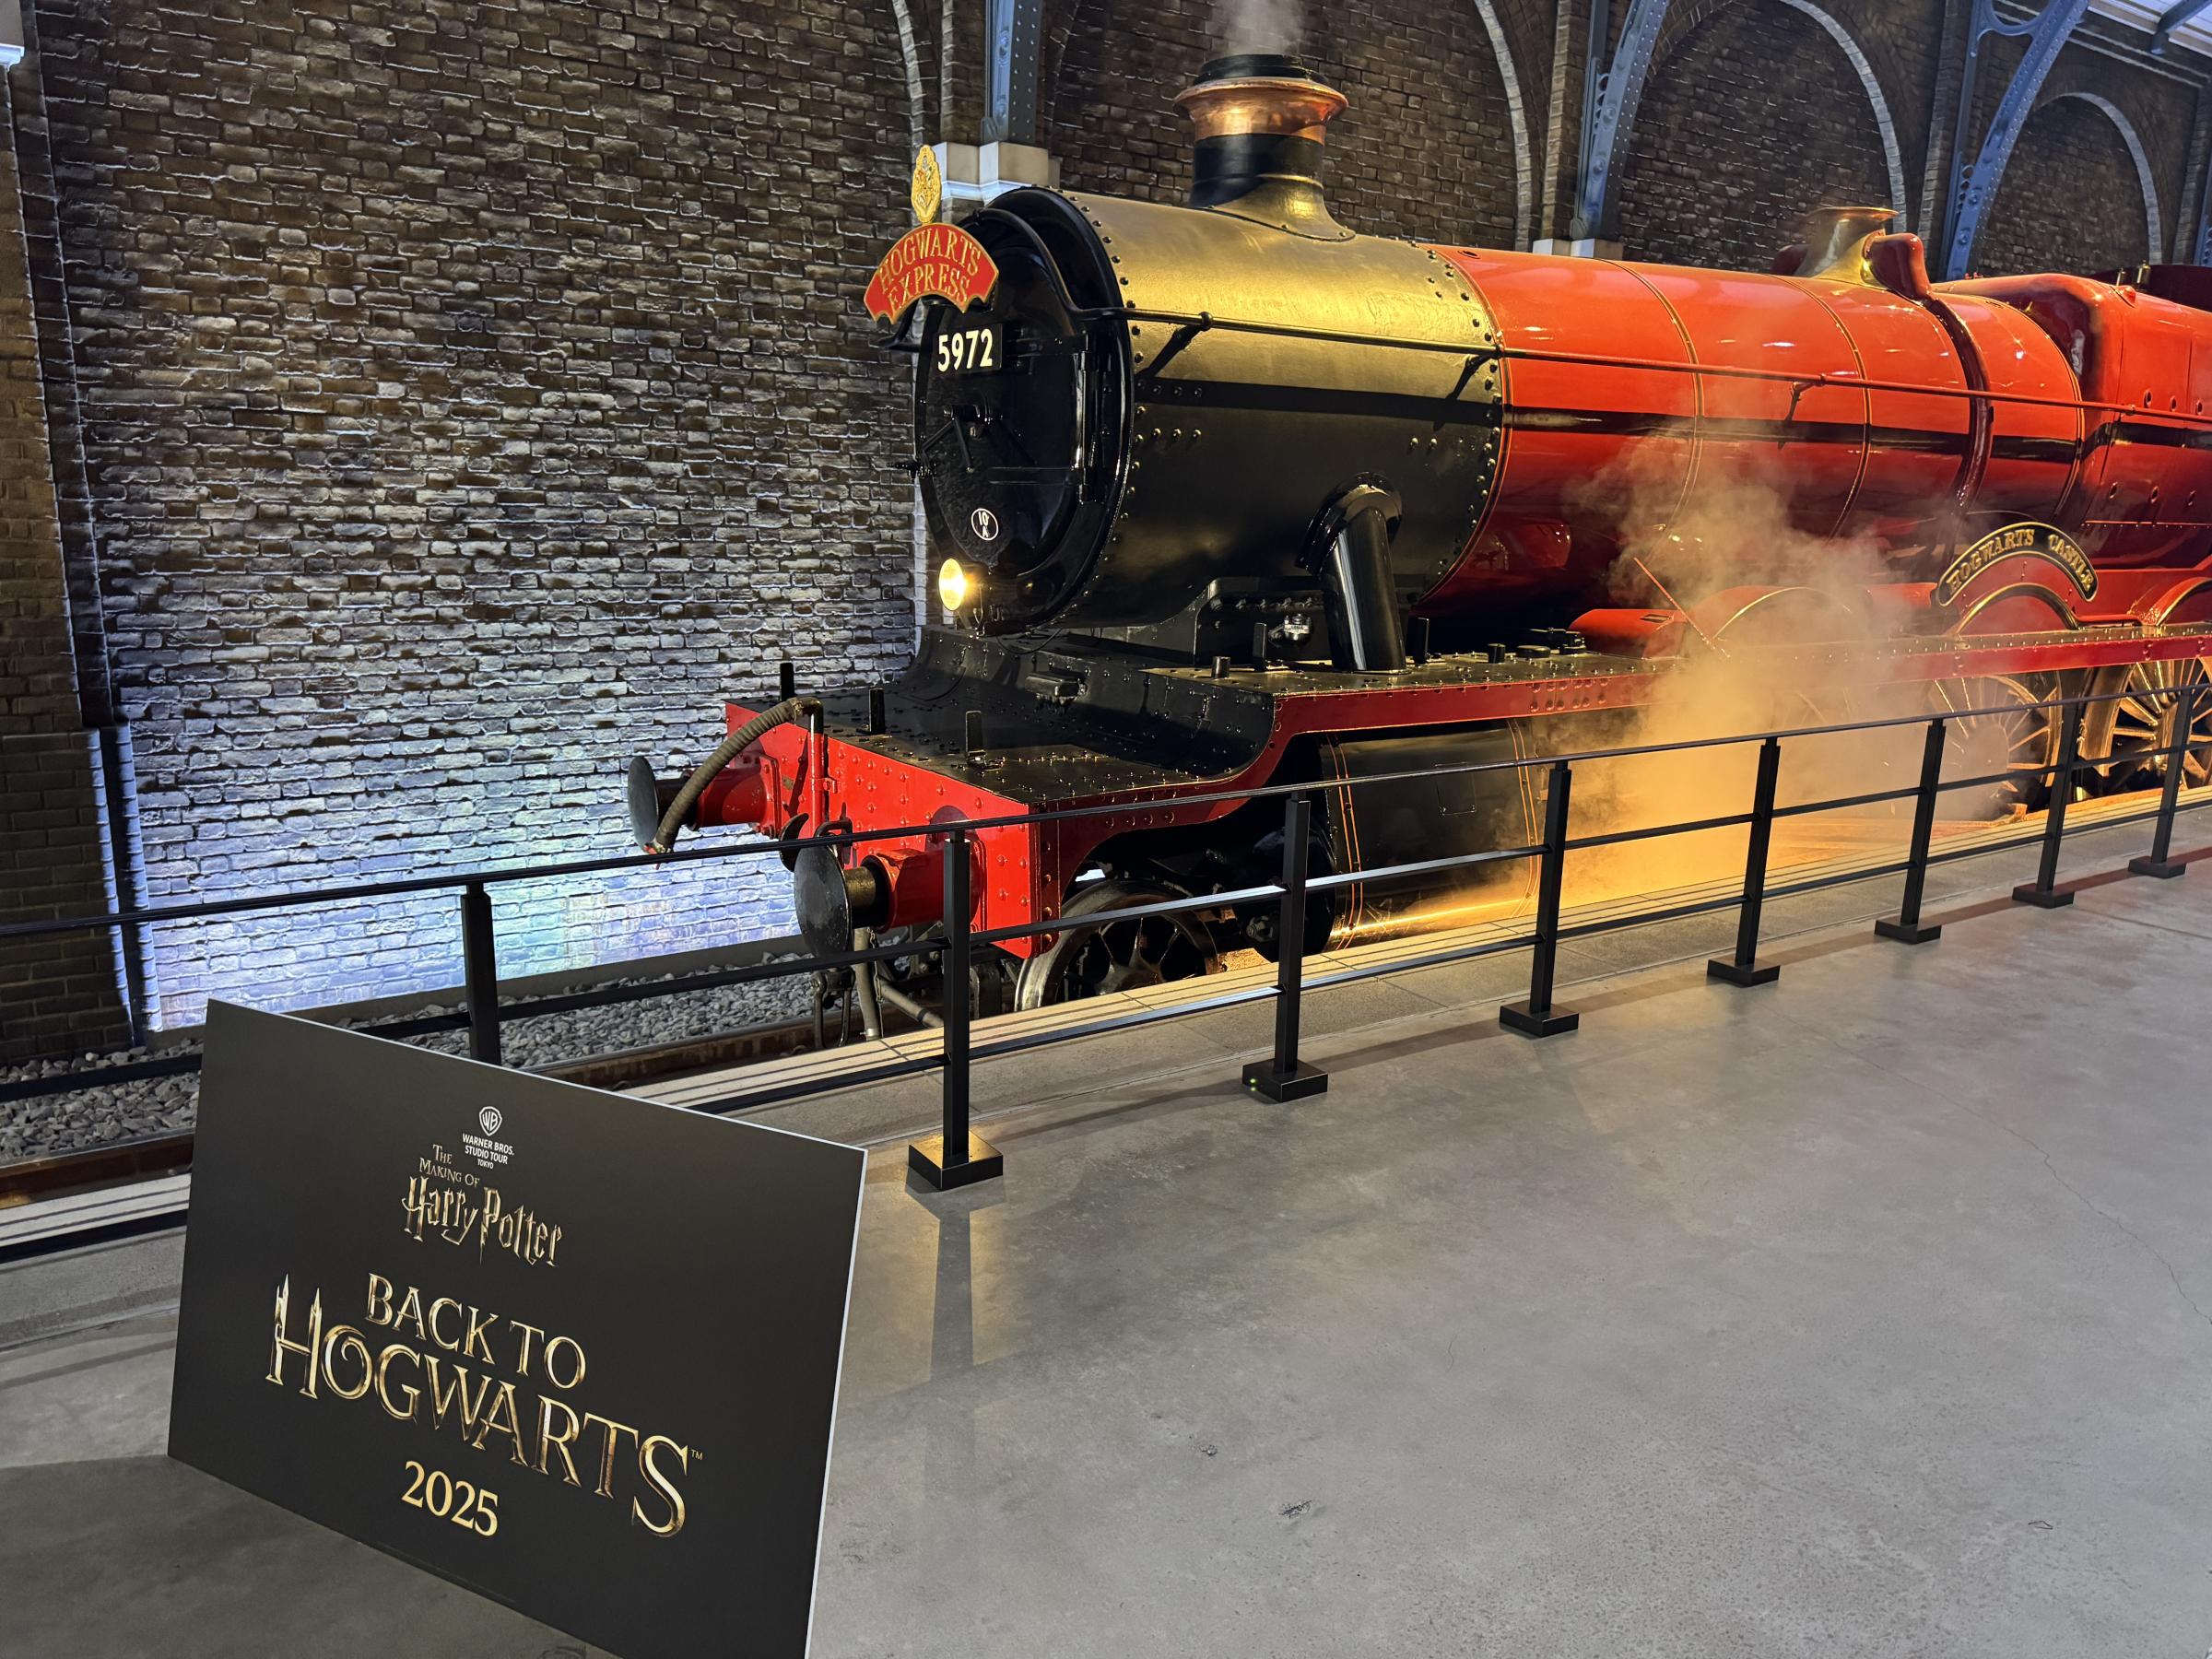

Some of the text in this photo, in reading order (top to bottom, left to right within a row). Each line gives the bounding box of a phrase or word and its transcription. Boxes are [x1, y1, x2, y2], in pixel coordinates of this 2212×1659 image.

[879, 228, 982, 294] HOGWARTS
[888, 262, 971, 314] EXPRESS
[937, 328, 993, 372] 5972
[1947, 529, 2094, 594] HOGWARTS CASTLE
[462, 1133, 514, 1156] WARNER BROS.
[481, 1109, 500, 1134] WB
[465, 1145, 508, 1165] STUDIO TOUR
[477, 1159, 494, 1170] TOKYO
[402, 1175, 562, 1266] Harry Potter
[366, 1273, 586, 1390] BACK TO
[265, 1273, 689, 1538] HOGWARTS
[401, 1460, 500, 1537] 2025
